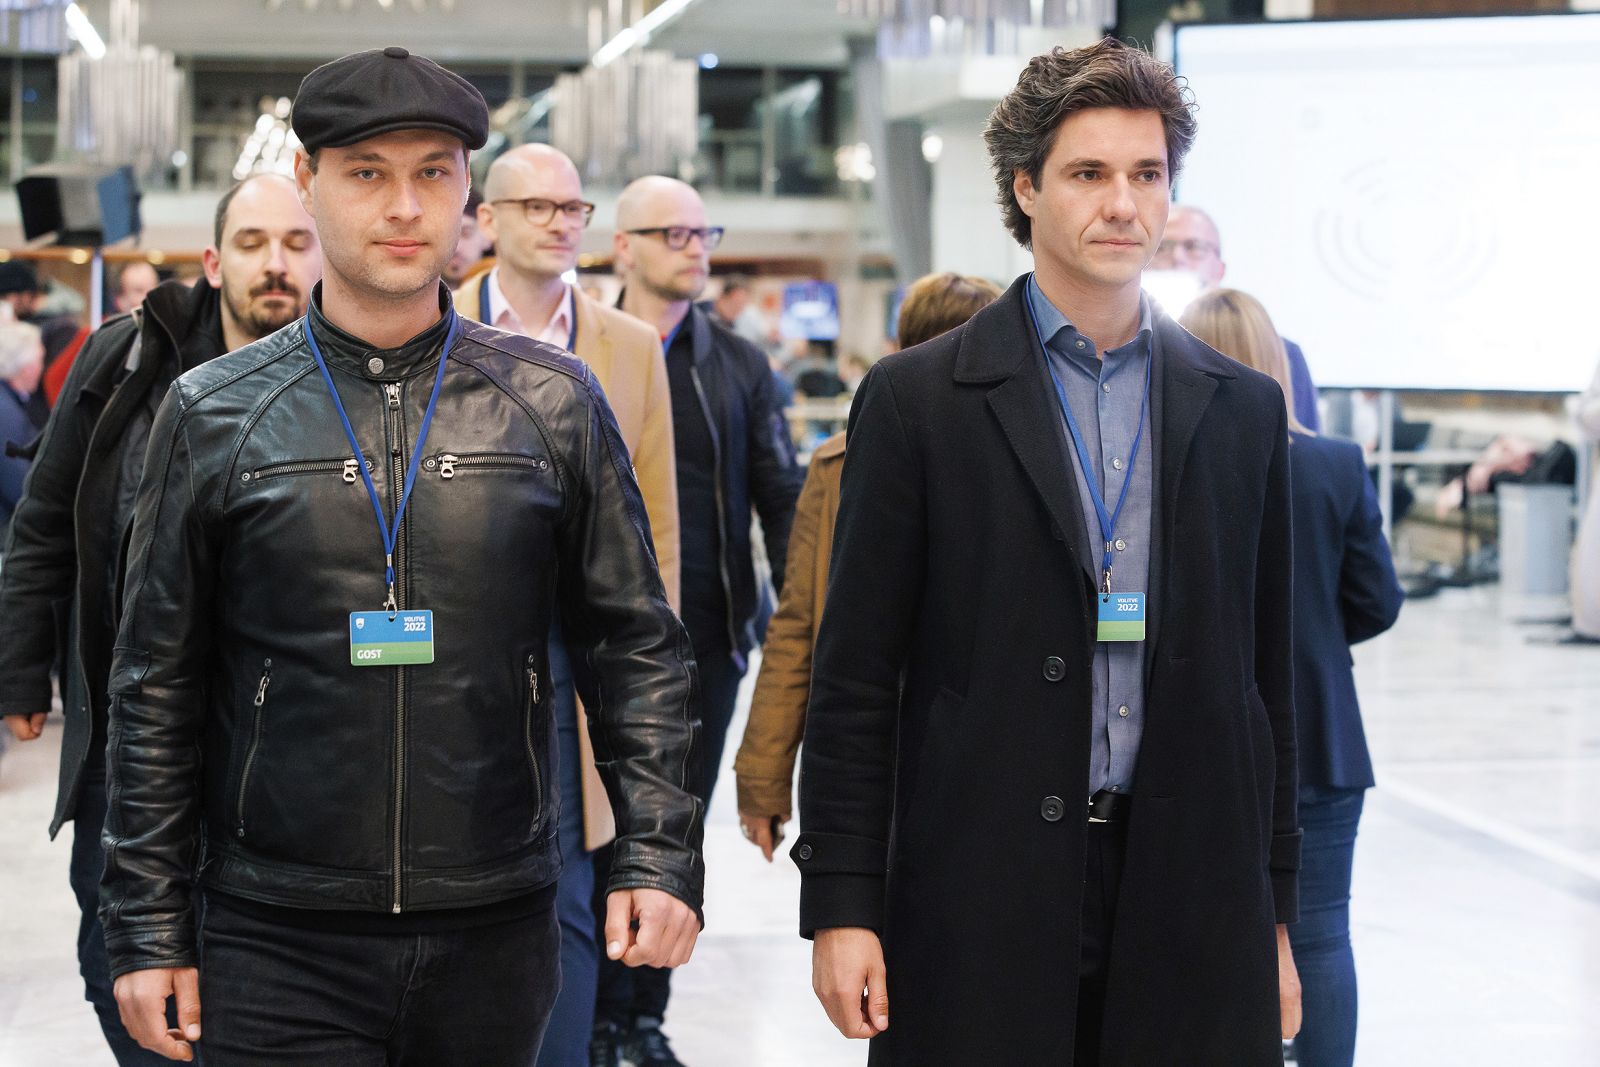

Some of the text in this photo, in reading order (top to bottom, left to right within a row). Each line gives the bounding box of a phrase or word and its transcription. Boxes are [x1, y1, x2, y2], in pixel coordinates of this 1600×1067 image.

[1117, 603, 1138, 611] 2022
[403, 622, 426, 632] 2022
[356, 649, 382, 659] GOST
